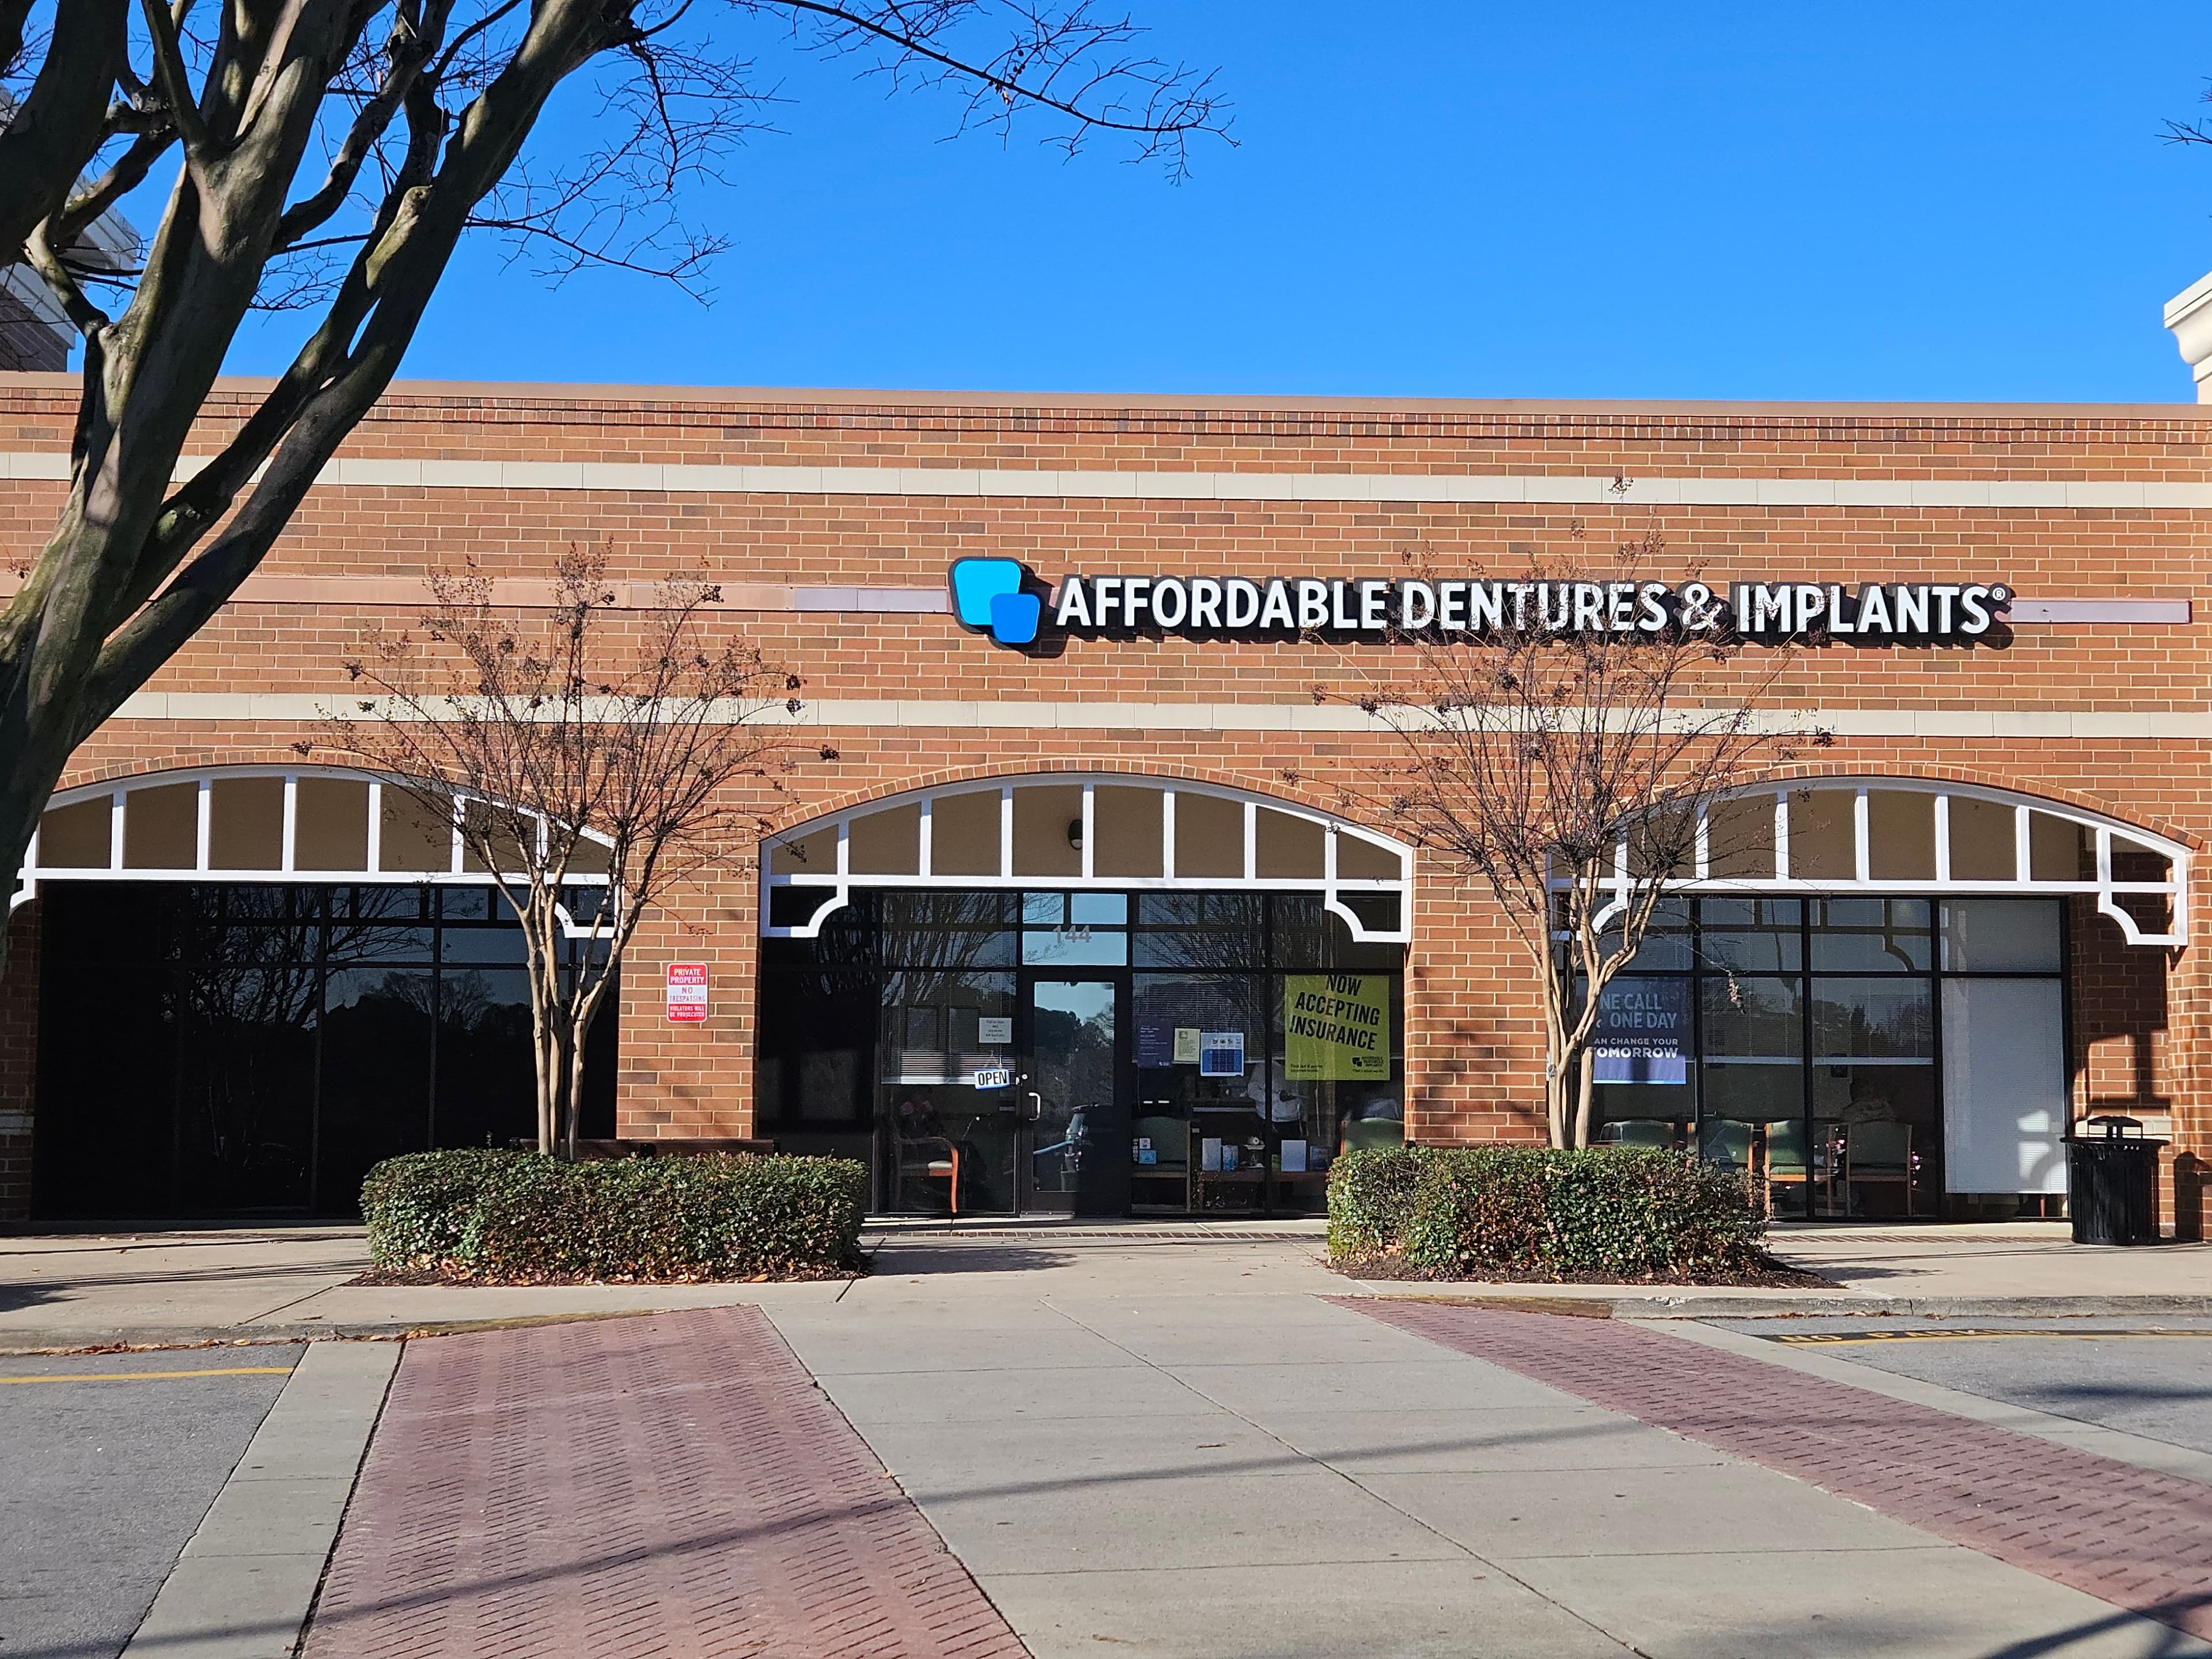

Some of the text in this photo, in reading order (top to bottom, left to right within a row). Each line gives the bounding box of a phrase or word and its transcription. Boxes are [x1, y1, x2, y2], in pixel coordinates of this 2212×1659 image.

[1056, 578, 1387, 628] AFFORDABLE
[1402, 582, 1668, 631] DENTURES
[1682, 583, 1724, 630] &
[1052, 925, 1092, 943] 144
[1326, 974, 1362, 997] NOW
[1294, 991, 1380, 1026] ACCEPTING
[1600, 993, 1662, 1010] NE CALL
[1609, 1012, 1642, 1028] ONE
[1646, 1012, 1677, 1029] DAY
[1289, 1014, 1377, 1051] INSURANCE
[1594, 1037, 1607, 1046] AN
[1610, 1037, 1649, 1046] CHANGE
[1594, 1047, 1679, 1058] OMORROW
[978, 1071, 1007, 1085] OPEN
[1779, 1334, 1842, 1342] NO
